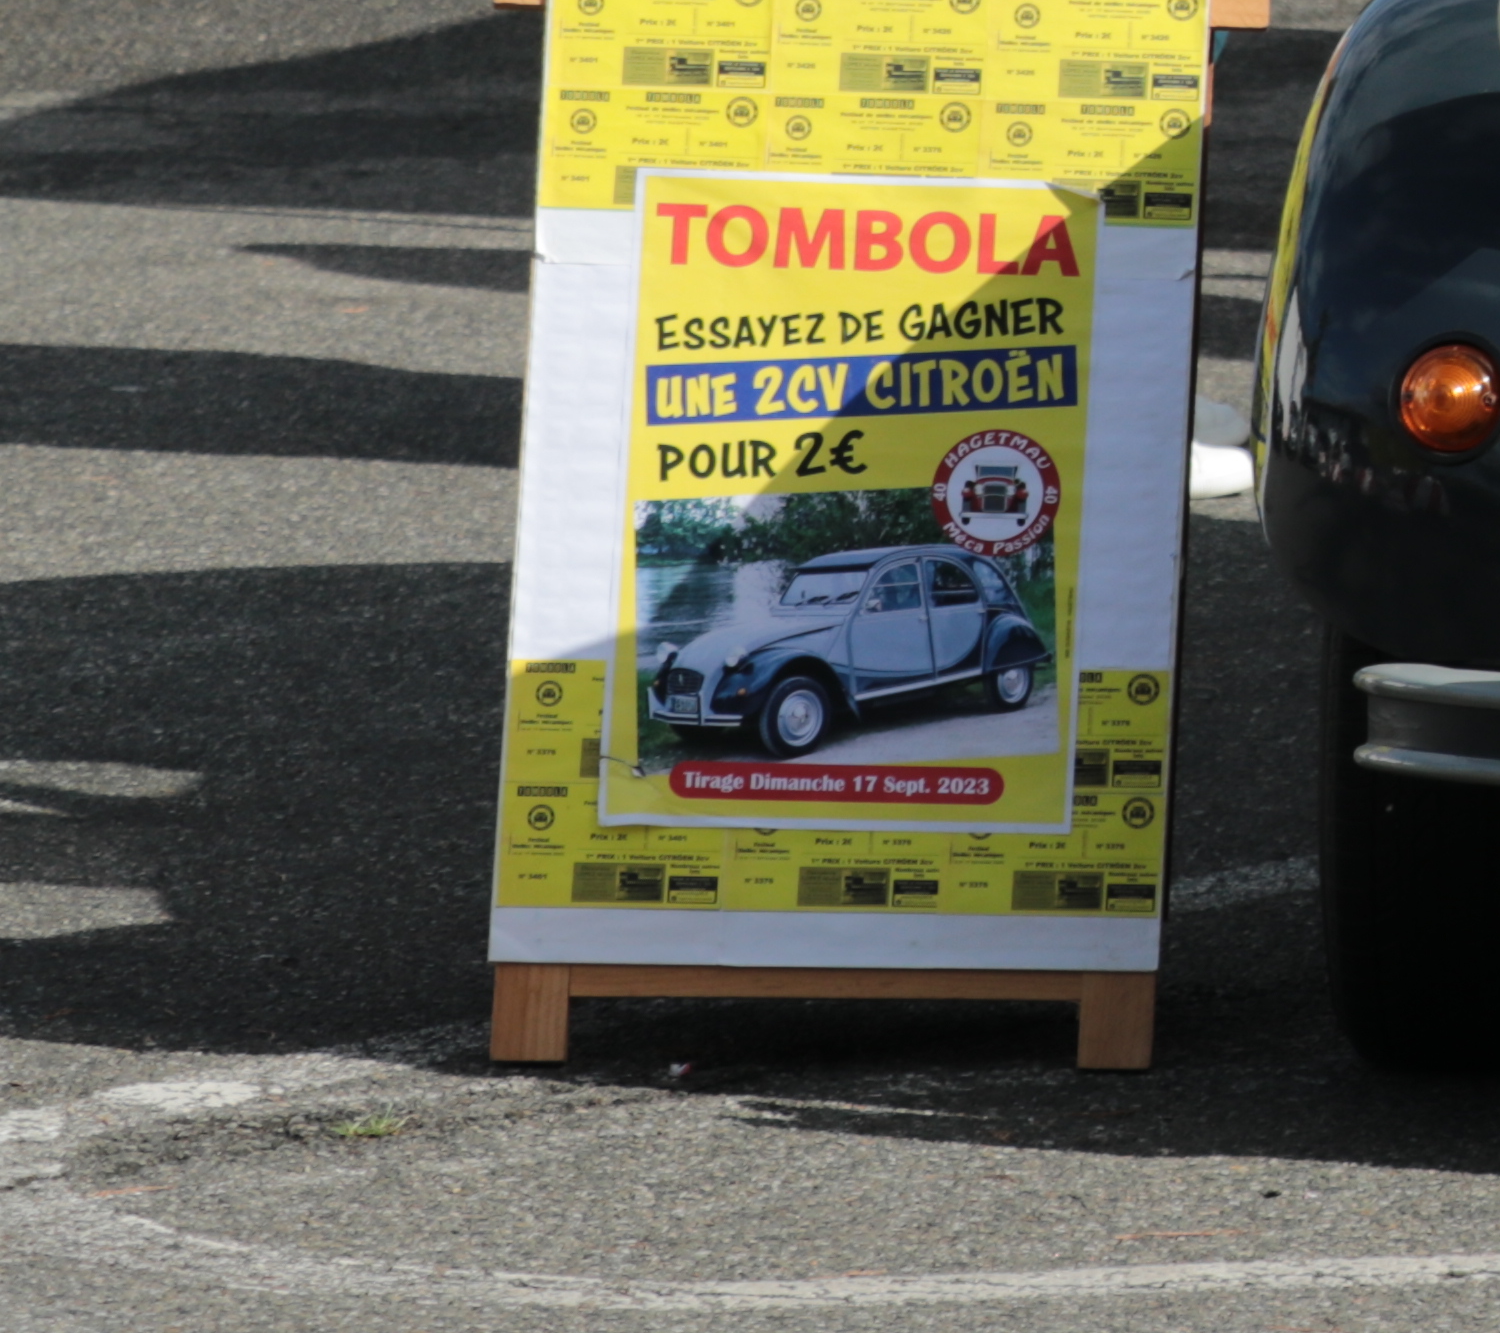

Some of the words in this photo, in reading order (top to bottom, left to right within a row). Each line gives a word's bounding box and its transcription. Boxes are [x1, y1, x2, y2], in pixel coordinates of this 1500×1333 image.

[656, 202, 1081, 277] TOMBOLA
[655, 313, 826, 351] ESSAYEZ
[838, 309, 885, 345] DE
[899, 297, 1065, 342] GAGNER
[655, 373, 738, 419] UNE
[752, 363, 849, 416] 2CV
[865, 349, 1065, 410] CITROËN
[657, 440, 778, 483] POUR
[794, 429, 869, 478] 2€
[944, 432, 1051, 469] HAGETMAU
[933, 483, 947, 501] 40
[1044, 486, 1058, 504] 40
[993, 514, 1050, 554] Passion
[683, 771, 744, 794] Tirage
[750, 773, 845, 792] Dimanche
[852, 775, 878, 793] 17
[883, 776, 931, 797] Sept.
[937, 777, 990, 796] 2023
